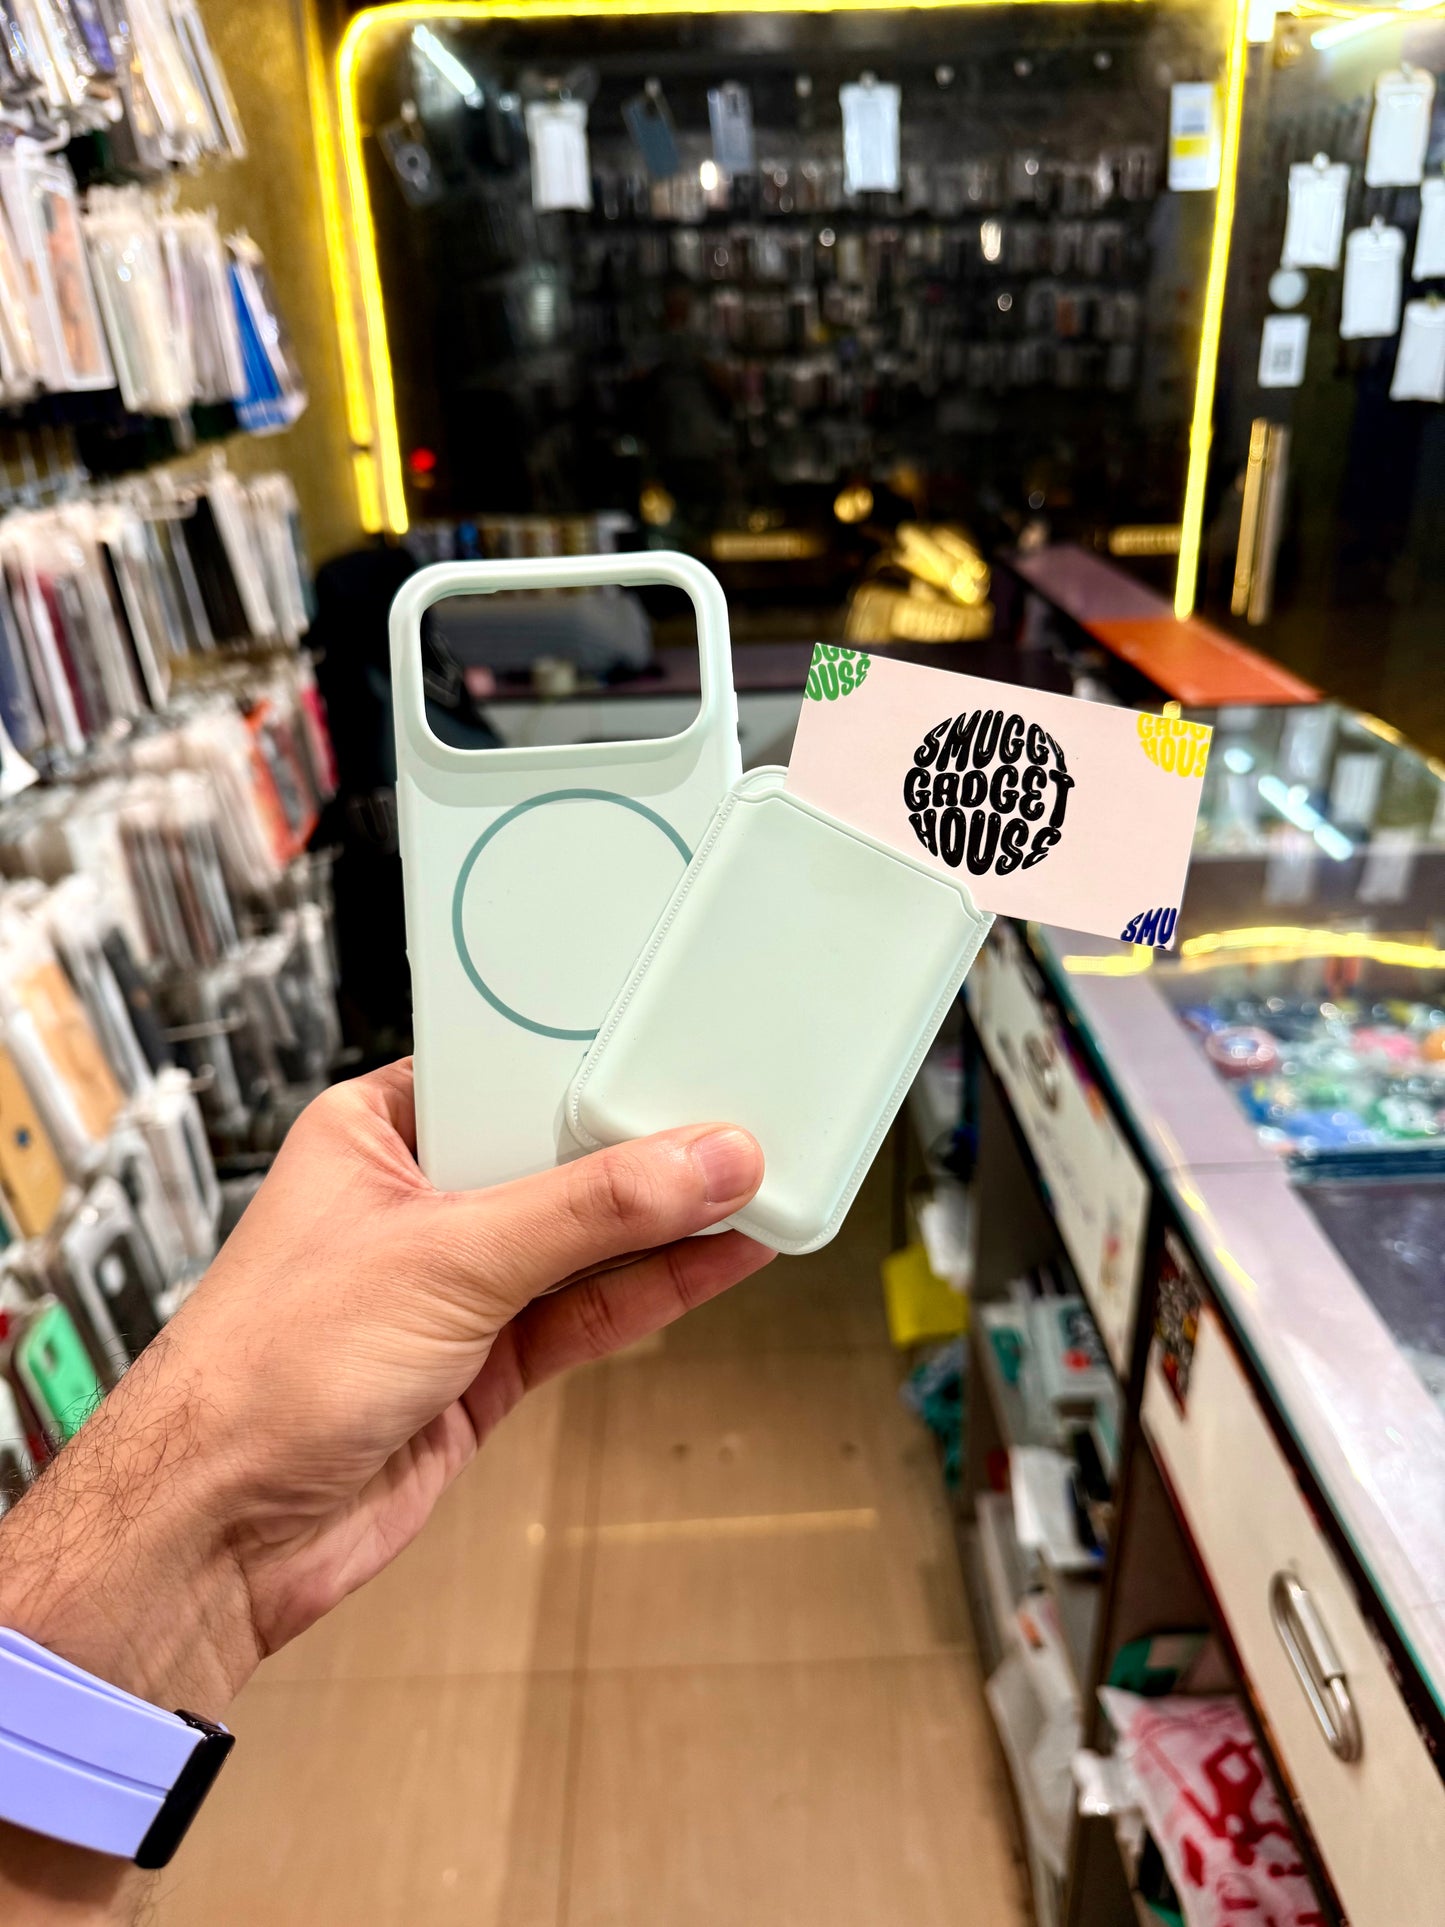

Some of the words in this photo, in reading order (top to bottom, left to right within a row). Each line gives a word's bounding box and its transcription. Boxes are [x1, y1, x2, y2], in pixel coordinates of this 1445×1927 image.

[913, 709, 1068, 773] SMUGGY
[903, 764, 1075, 829] GADGET
[908, 806, 1062, 876] HOUSE
[1120, 907, 1177, 947] SMU
